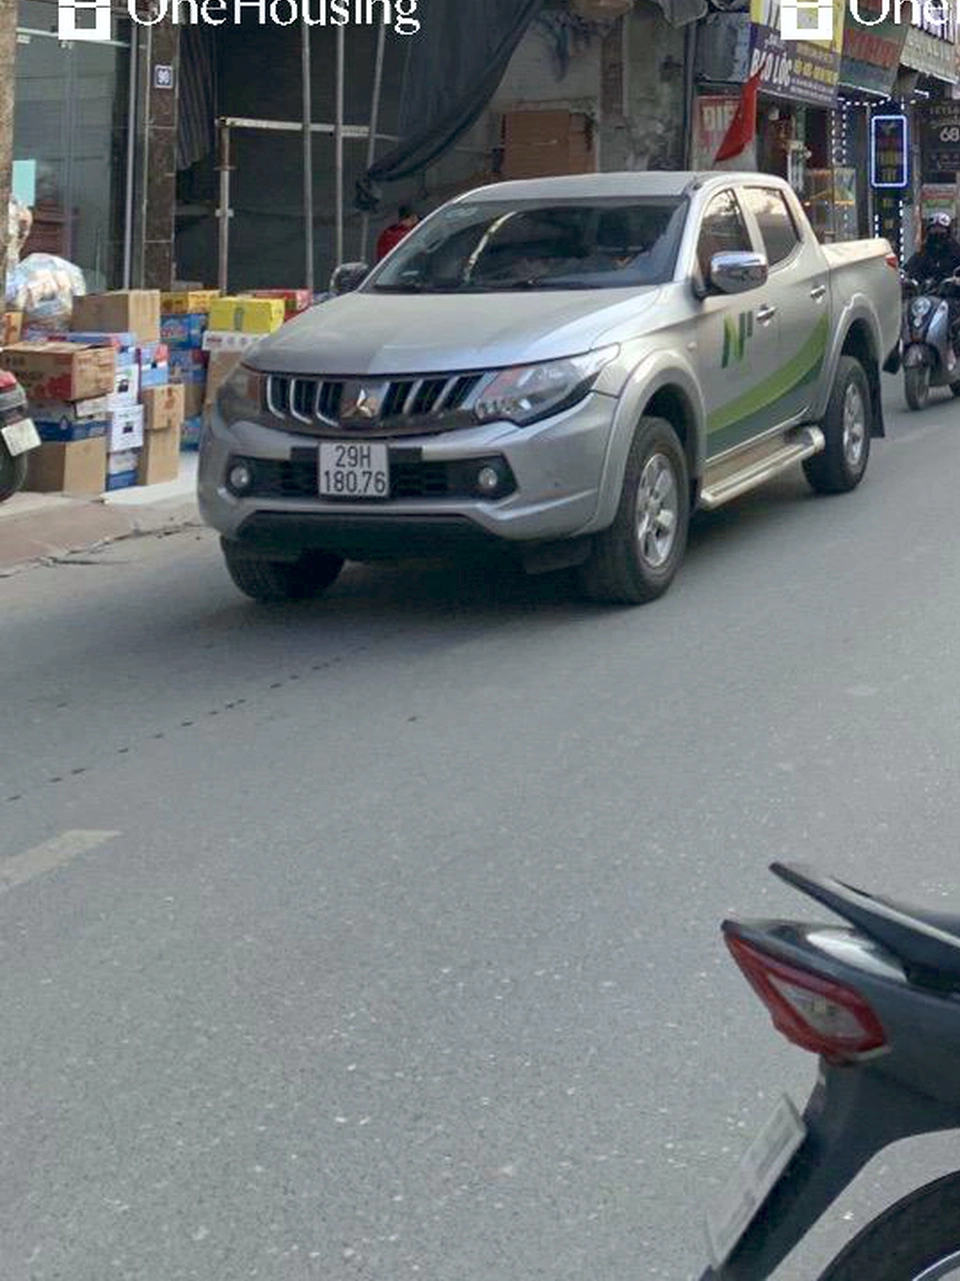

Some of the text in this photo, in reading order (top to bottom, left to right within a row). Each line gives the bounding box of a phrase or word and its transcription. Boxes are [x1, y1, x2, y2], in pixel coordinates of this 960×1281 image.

[939, 126, 960, 142] 68
[335, 445, 371, 468] 29H
[324, 470, 386, 493] 180.76
